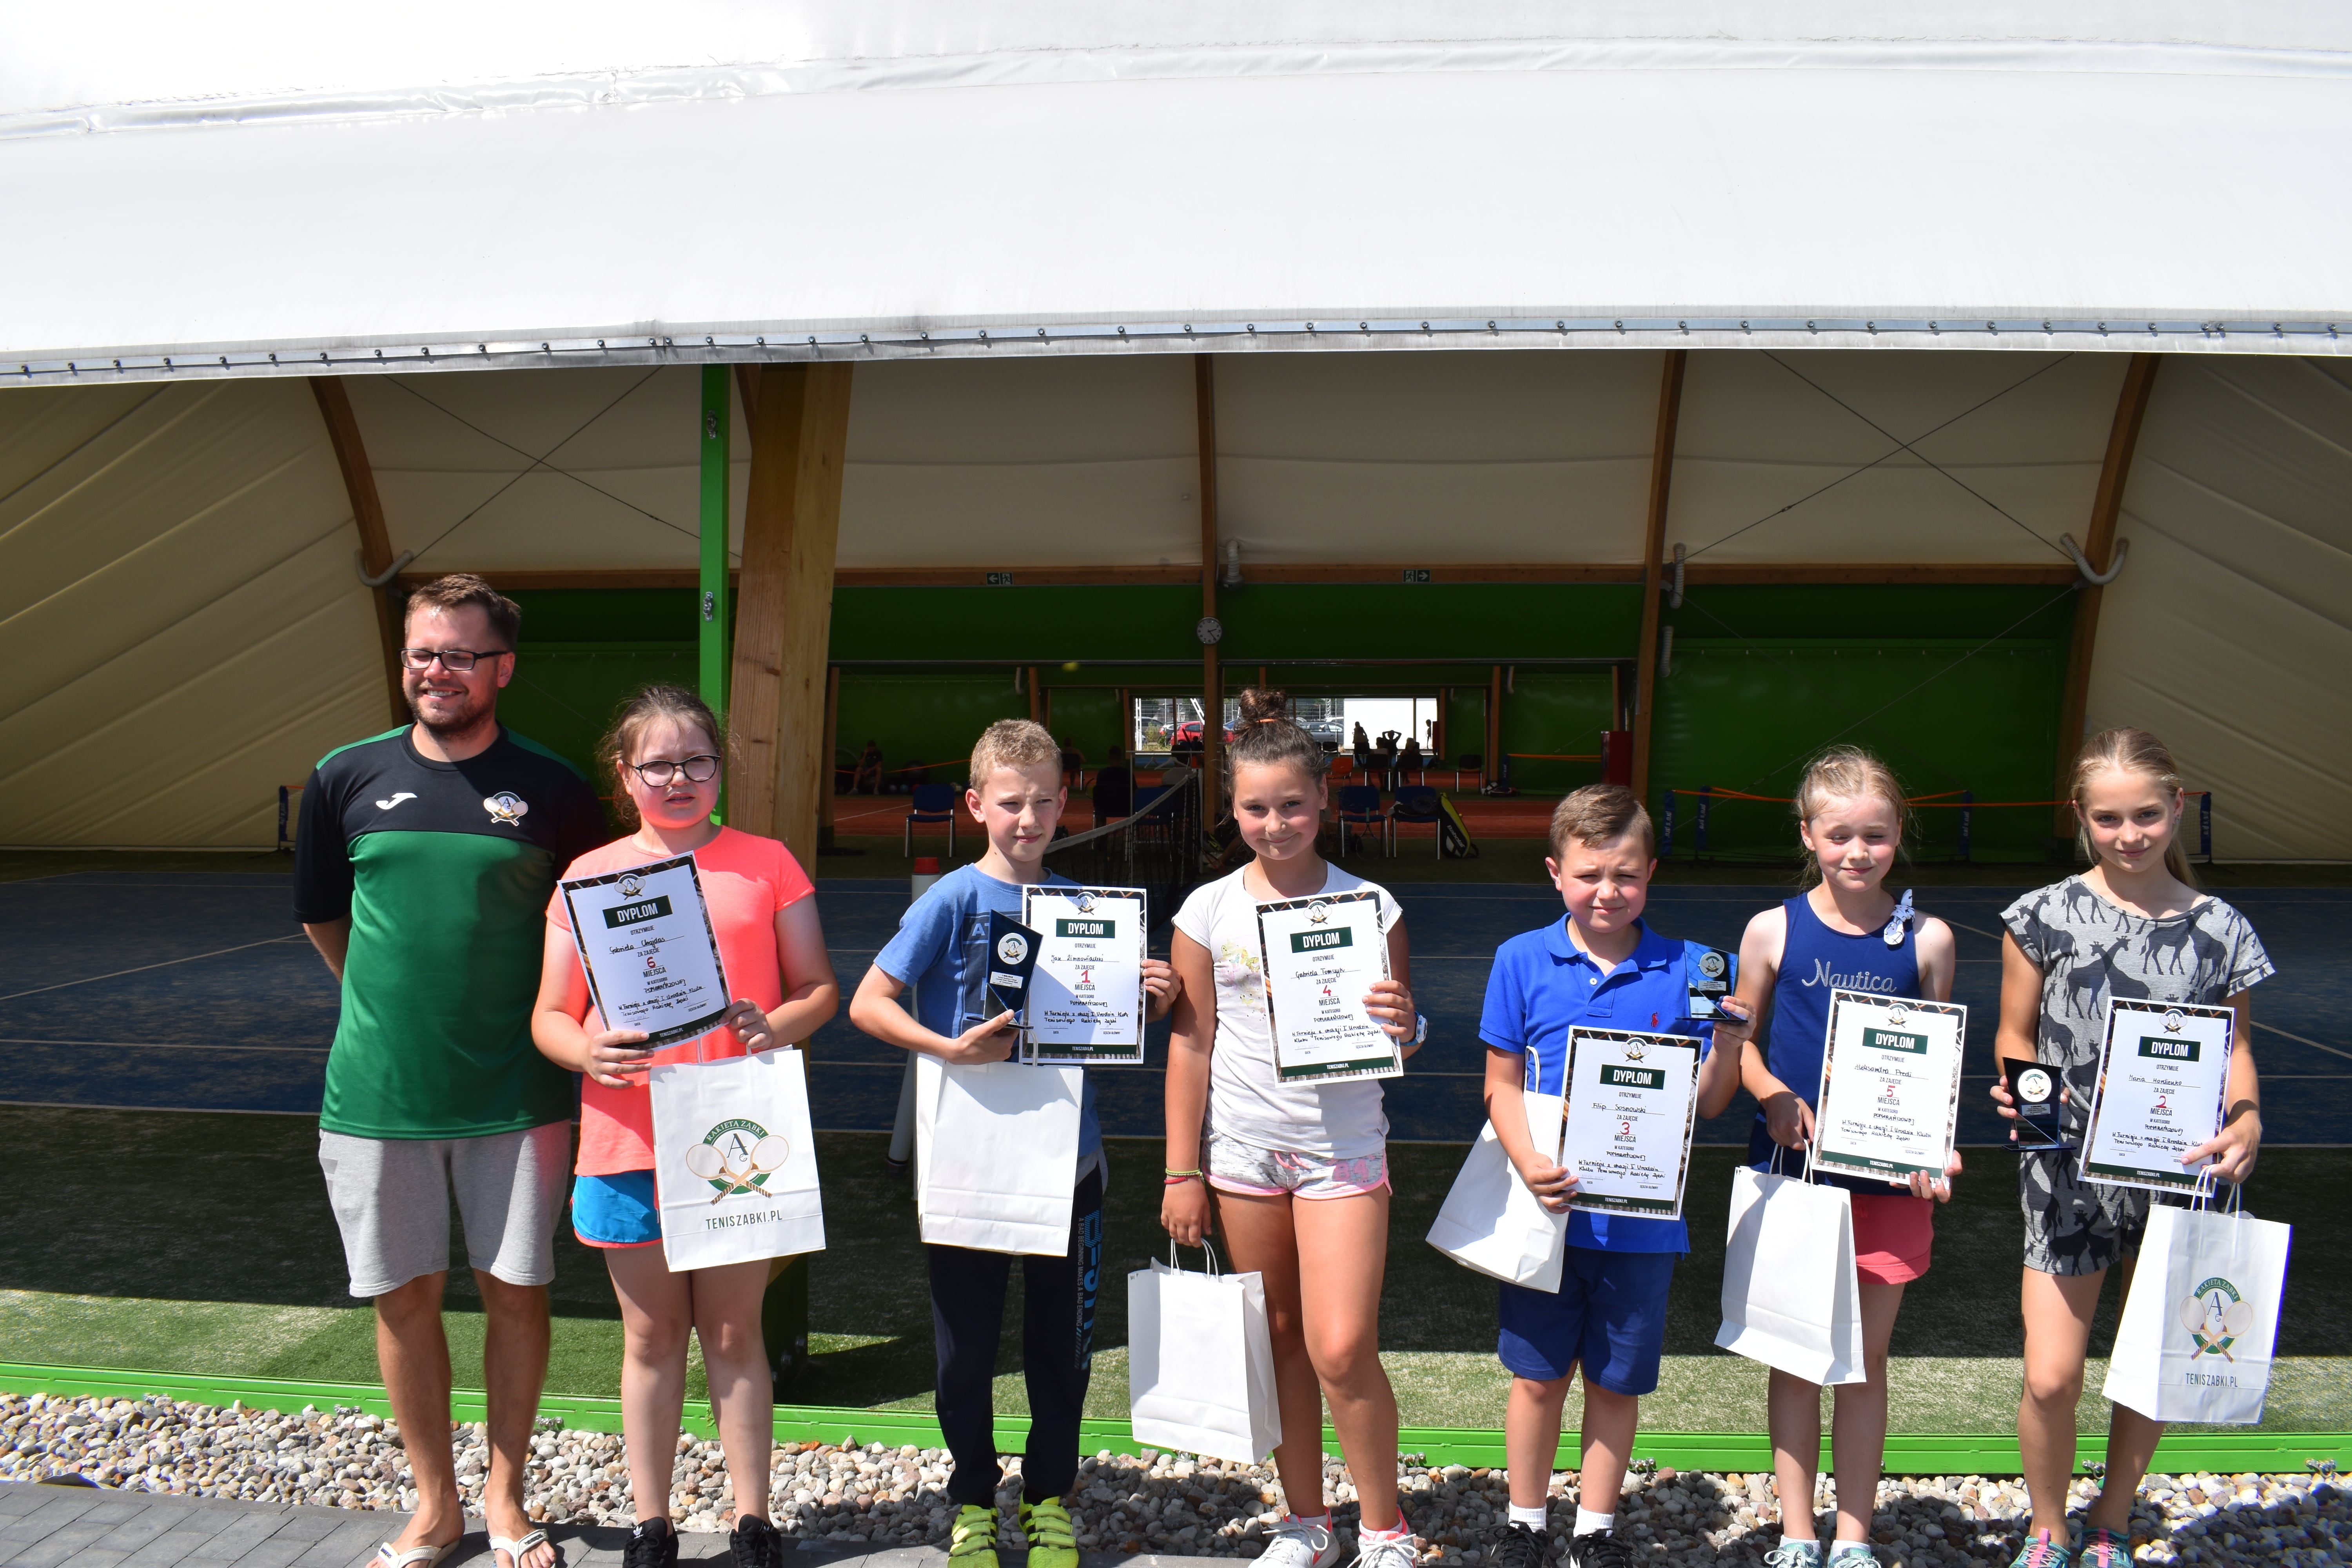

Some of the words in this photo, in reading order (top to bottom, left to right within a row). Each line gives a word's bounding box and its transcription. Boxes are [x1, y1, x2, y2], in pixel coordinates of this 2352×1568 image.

[1447, 825, 1465, 848] Babolat
[617, 902, 658, 922] DYPLOM
[630, 925, 655, 935] OTRZYMUJE
[1068, 922, 1103, 935] DYPLOM
[1303, 932, 1340, 948] DYPLOM
[609, 944, 635, 955] Gabriela
[643, 947, 660, 956] ZAJĘCIE
[647, 956, 656, 969] 6
[1051, 955, 1062, 963] Jan
[642, 966, 666, 978] MIEJSCA
[1081, 970, 1090, 983] 1
[1296, 970, 1318, 980] Gabriela
[1802, 958, 1897, 993] Nautica
[1323, 984, 1332, 996] 4
[1319, 998, 1340, 1006] MIEJSCA
[1875, 1033, 1915, 1049] DYPLOM
[2151, 1042, 2189, 1057] DYPLOM
[1613, 1069, 1652, 1085] DYPLOM
[2129, 1074, 2146, 1082] Maria
[1886, 1085, 1895, 1098] 5
[1877, 1097, 1900, 1105] MIEJSCA
[2156, 1095, 2167, 1109] 2
[1592, 1103, 1607, 1111] Filip
[1615, 1104, 1646, 1113] Sosnowski
[2150, 1107, 2172, 1116] MIEJSCA
[706, 1120, 739, 1142] RAKIETA
[1620, 1122, 1630, 1135] 3
[1614, 1134, 1636, 1143] MIEJSCA
[706, 1210, 783, 1230] TENISZABKI.PL
[2196, 1279, 2221, 1295] RAKIETA
[2186, 1373, 2238, 1387] TENISZABKI.PL
